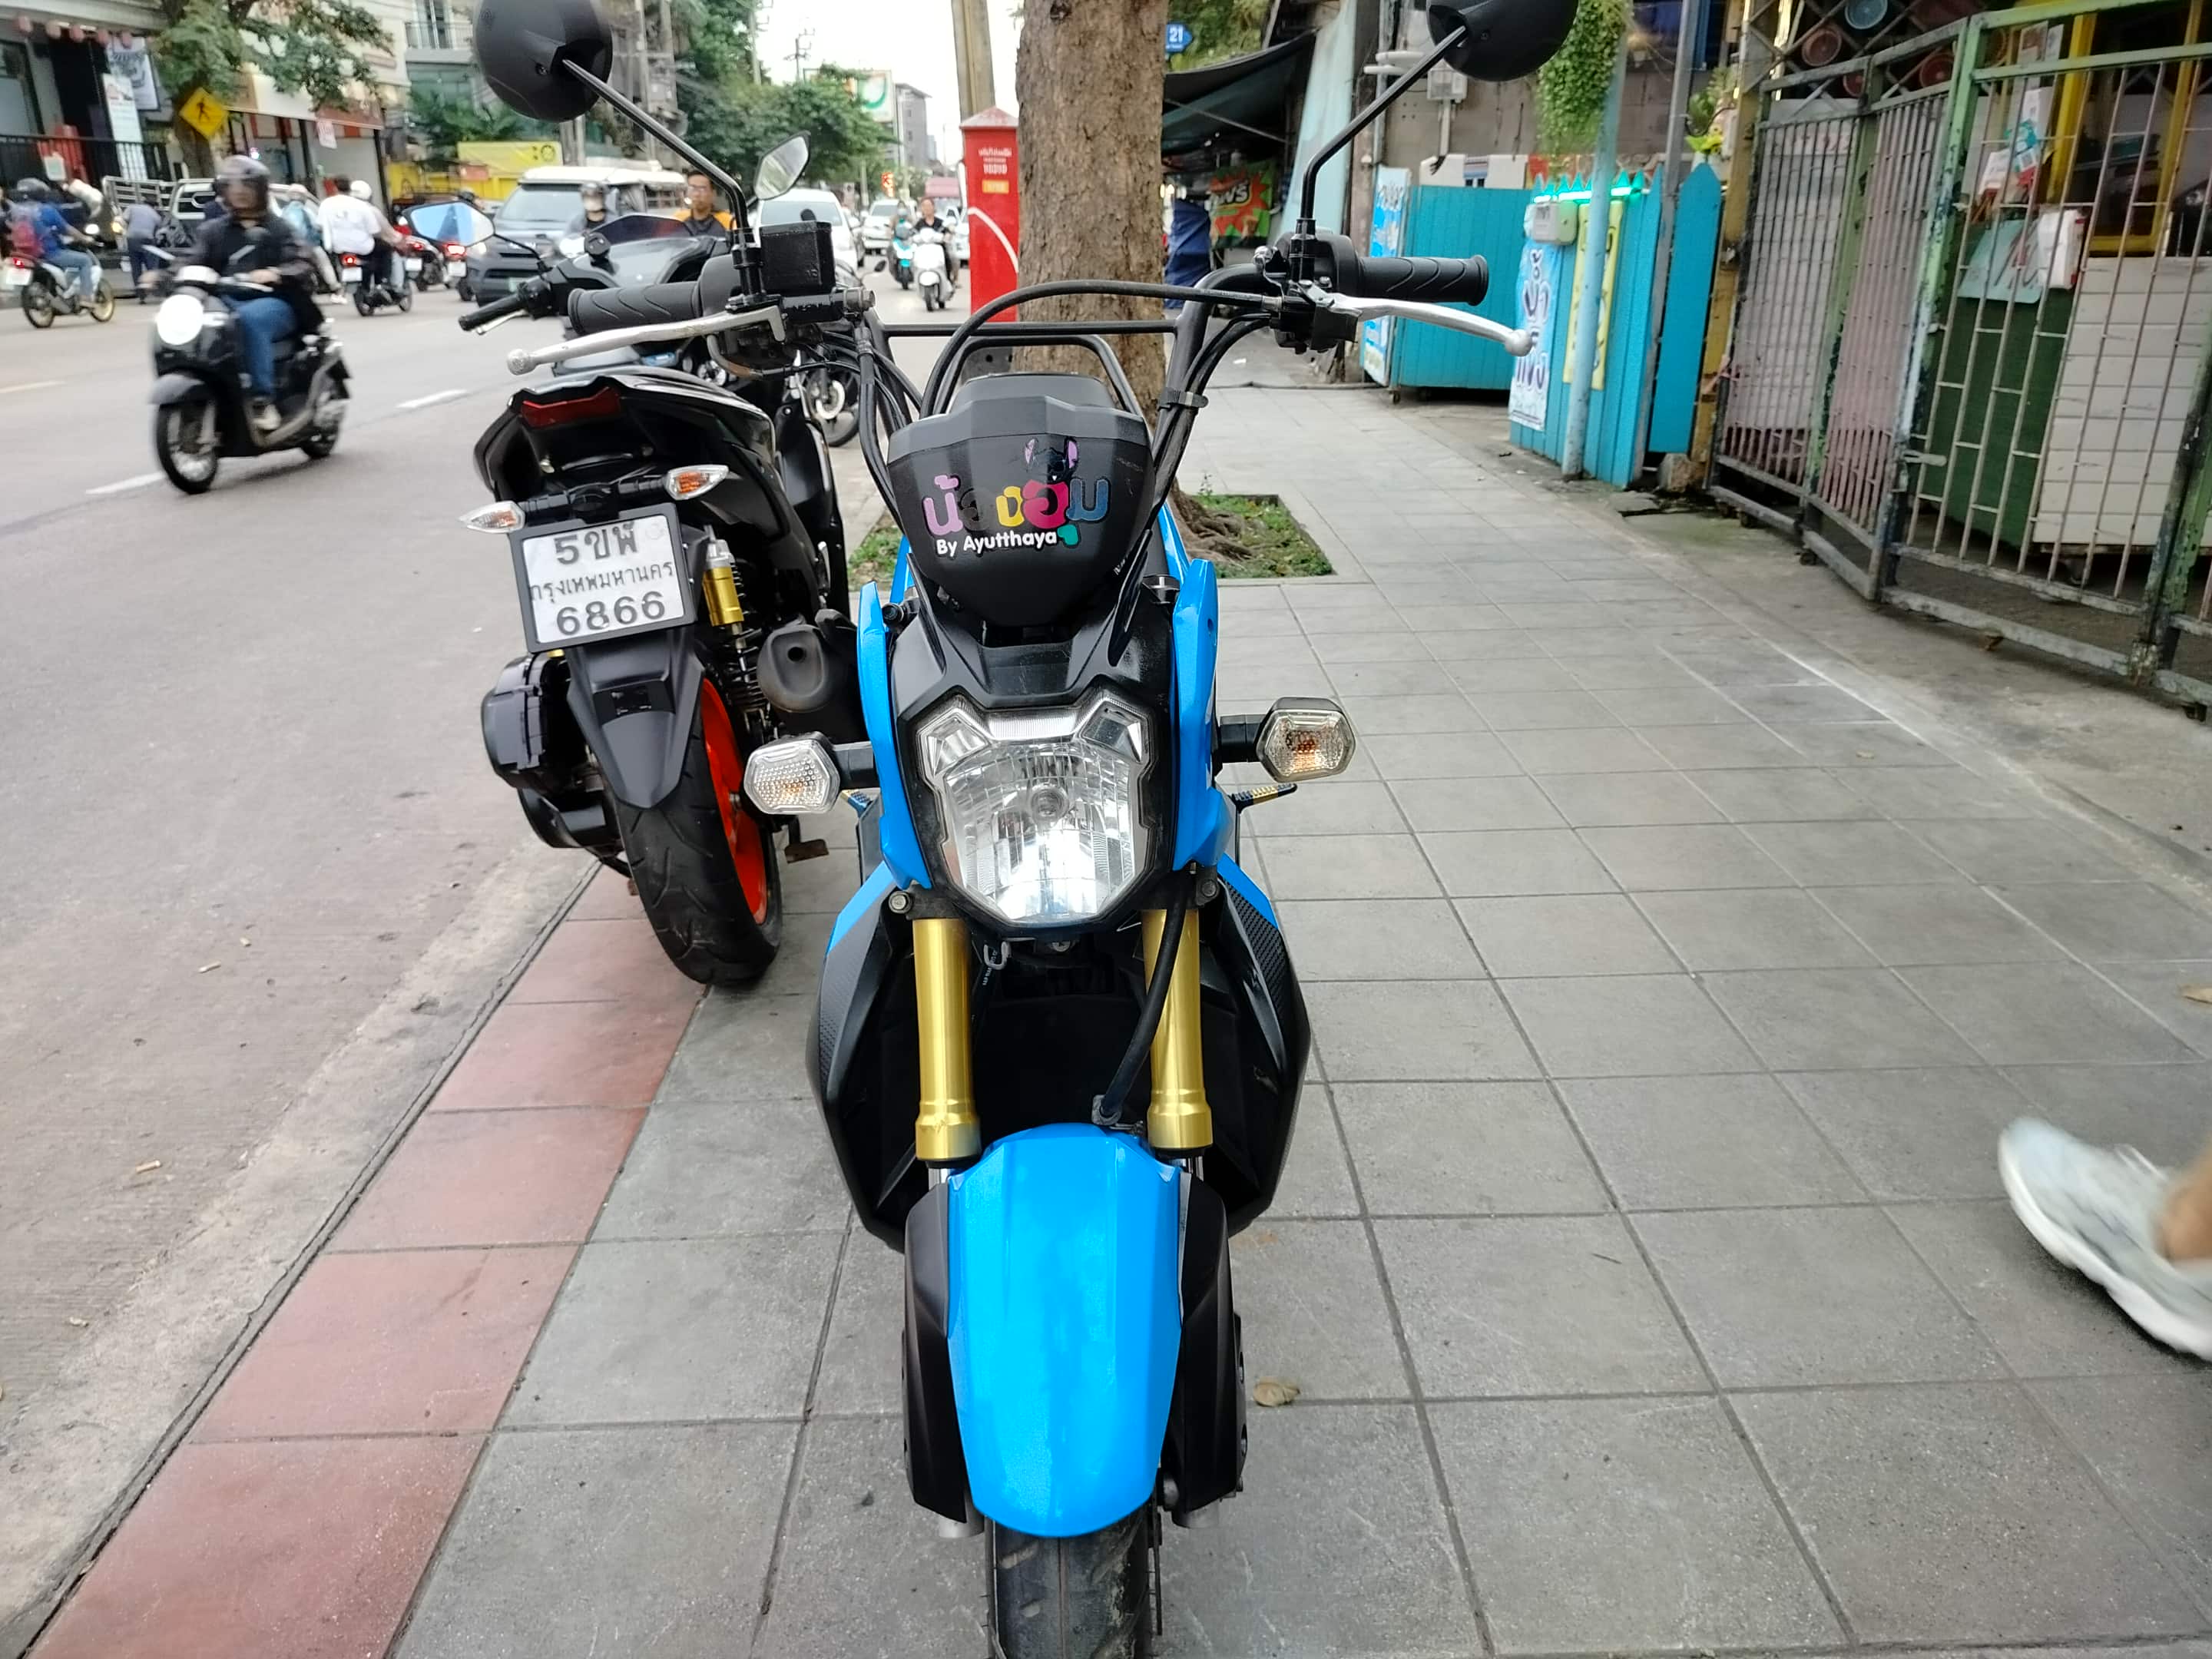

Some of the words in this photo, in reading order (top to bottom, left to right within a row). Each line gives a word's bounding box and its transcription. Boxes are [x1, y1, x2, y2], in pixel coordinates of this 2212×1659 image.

[1169, 25, 1184, 43] 21
[935, 538, 958, 558] By
[963, 530, 1058, 554] Ayutthaya
[531, 561, 674, 603] กรุงเทพมหานคร
[556, 591, 666, 636] 6866
